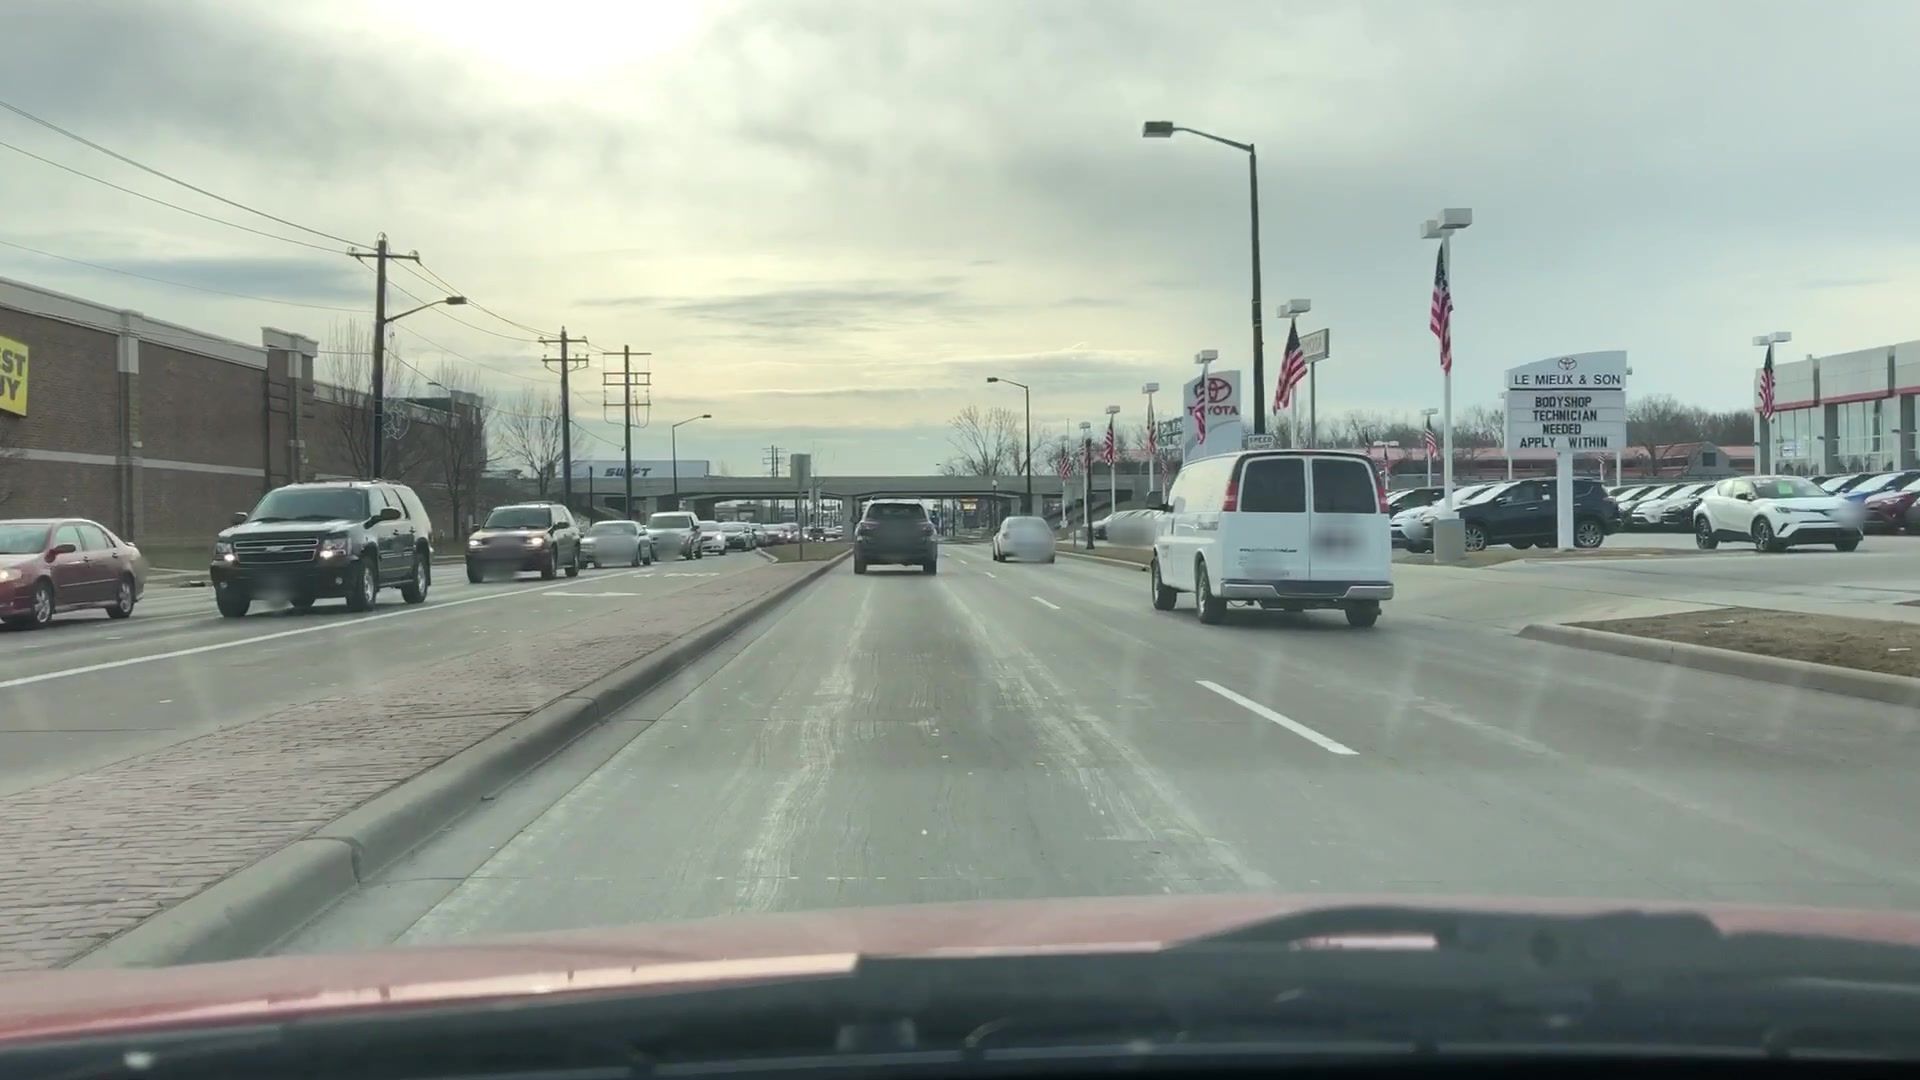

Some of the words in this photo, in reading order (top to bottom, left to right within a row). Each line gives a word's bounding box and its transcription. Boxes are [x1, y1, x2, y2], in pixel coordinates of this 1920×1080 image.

[0, 349, 26, 377] ST
[1514, 374, 1529, 385] LE
[1535, 374, 1573, 385] MIEUX
[1579, 374, 1587, 385] &
[1594, 374, 1621, 385] SON
[1535, 396, 1592, 408] BODYSHOP
[1187, 405, 1239, 416] TYOTA
[1533, 410, 1597, 421] TECHNICIAN
[1542, 423, 1582, 435] NEEDED
[1520, 437, 1556, 448] APPLY
[1568, 437, 1608, 448] WITHIN
[604, 467, 652, 477] SWFT
